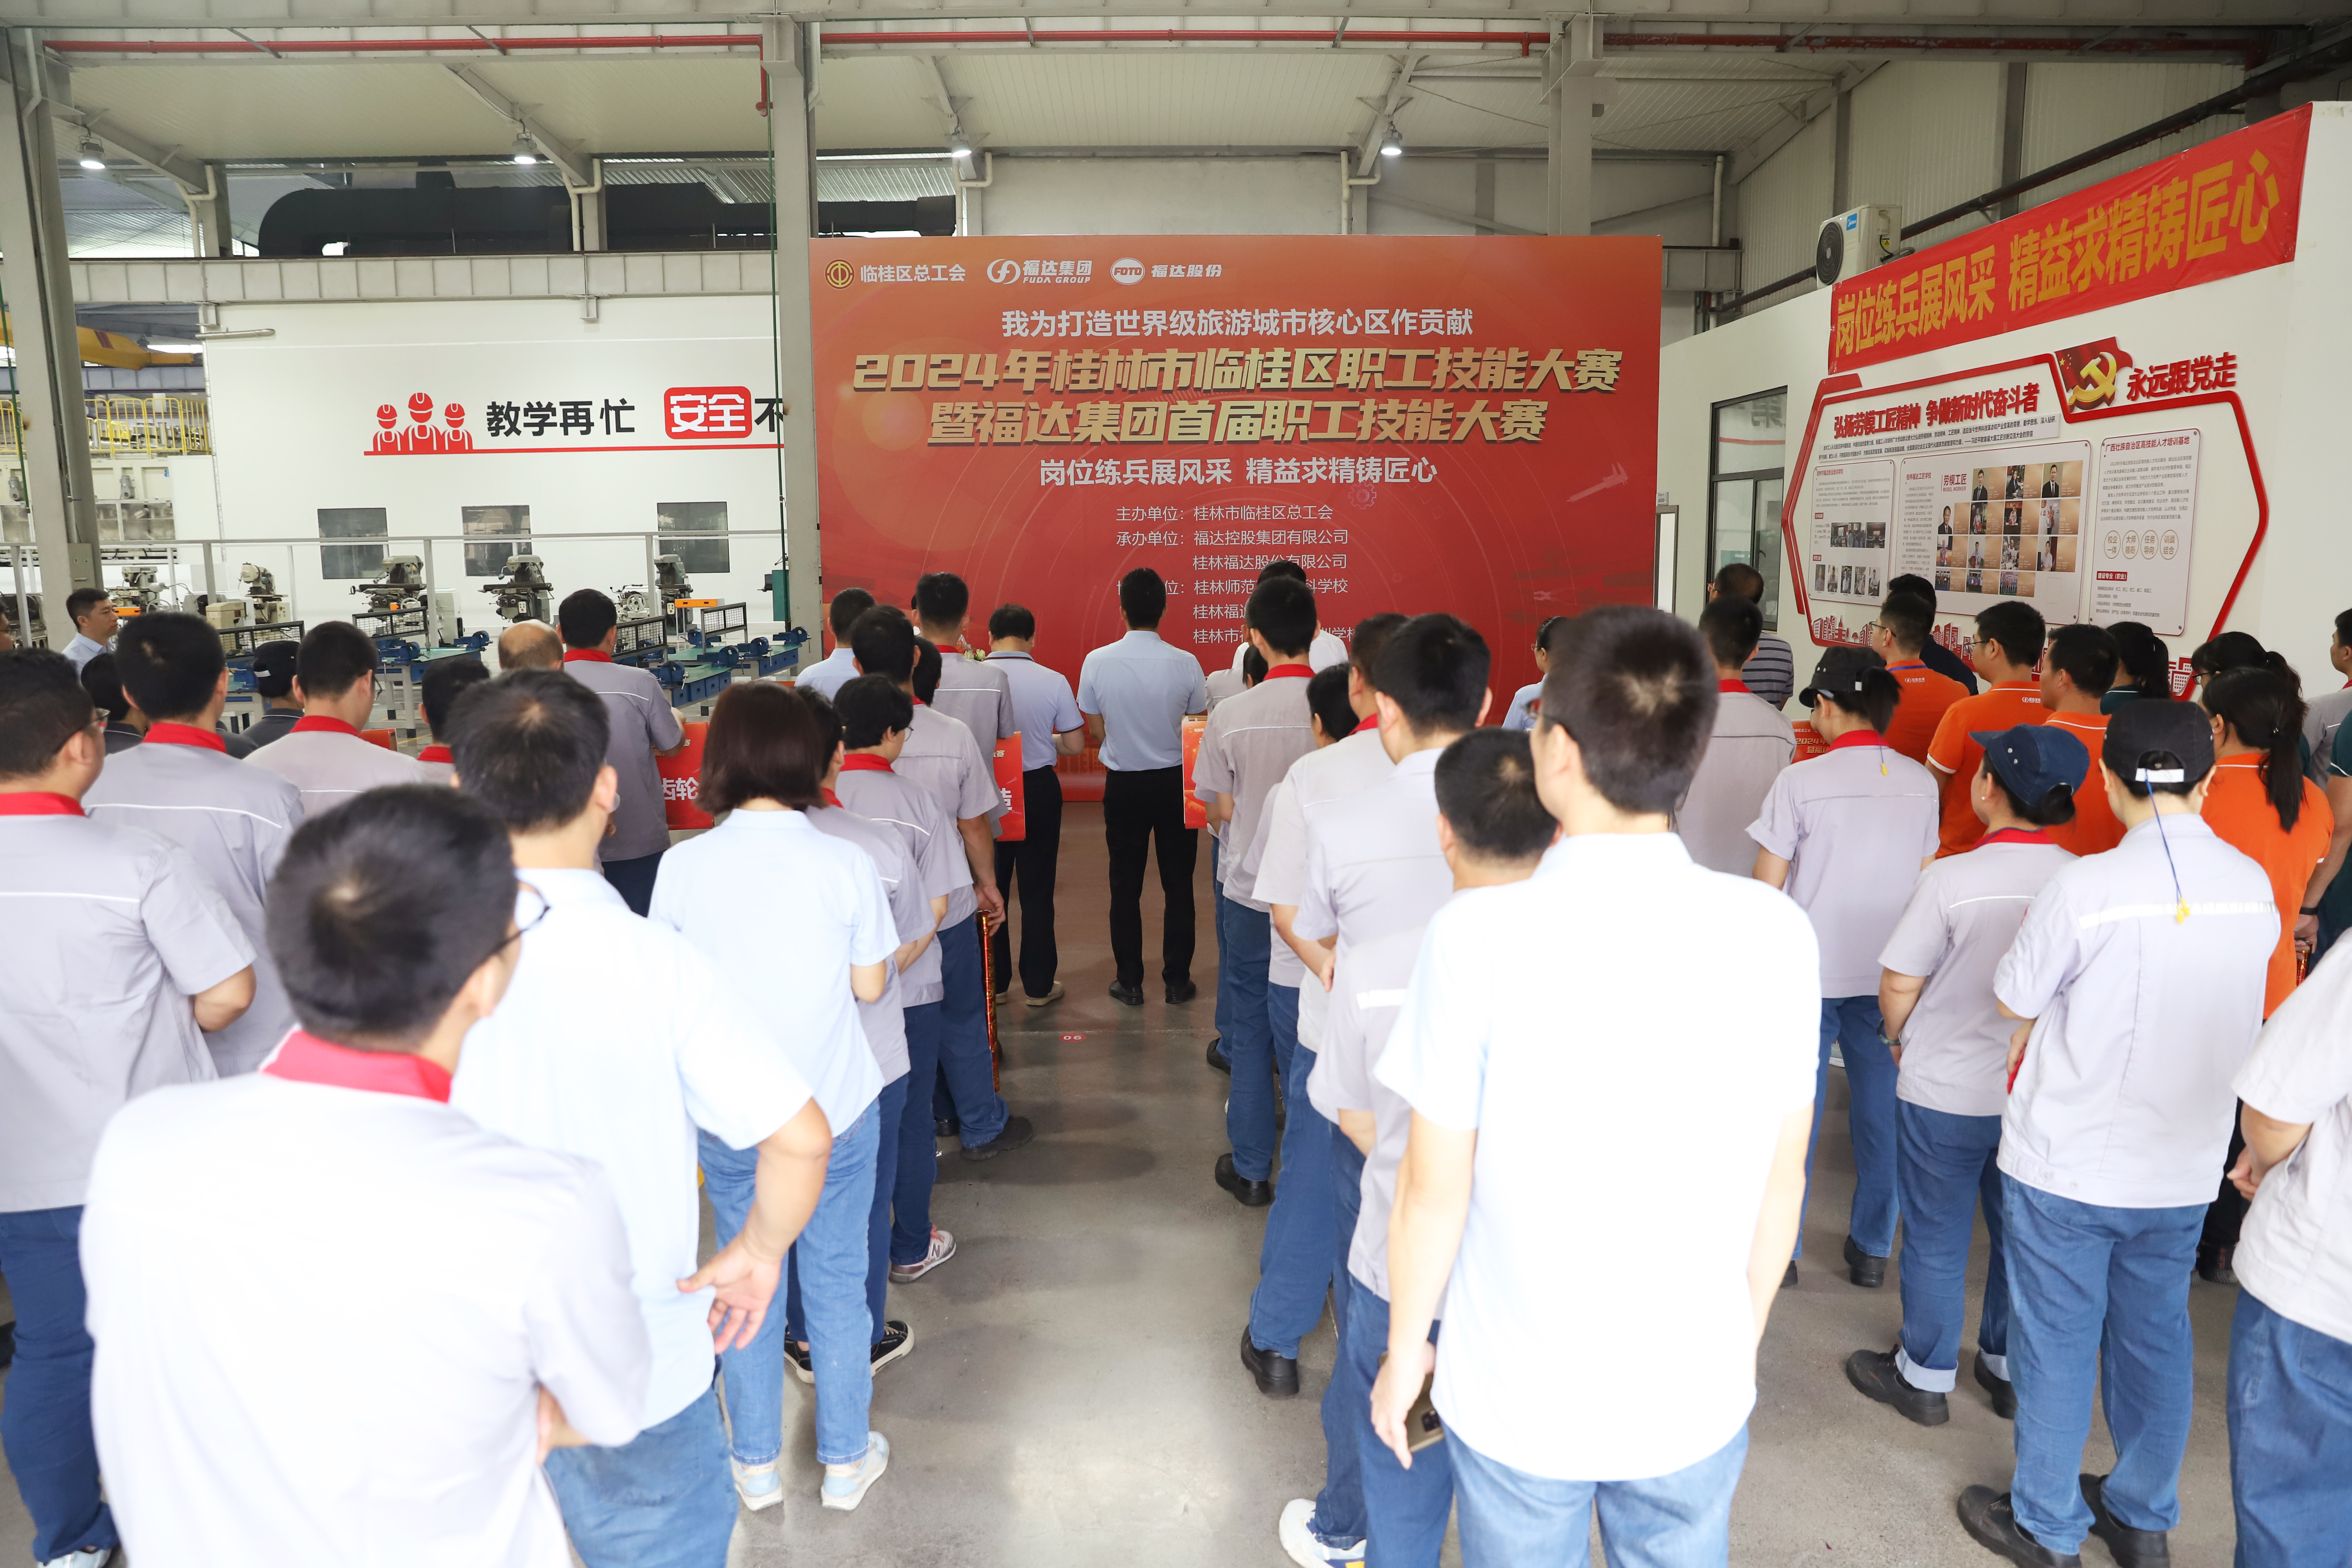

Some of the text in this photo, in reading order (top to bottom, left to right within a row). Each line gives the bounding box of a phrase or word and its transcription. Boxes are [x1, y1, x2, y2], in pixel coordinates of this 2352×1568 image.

[1836, 149, 2280, 357] 岗位练兵展风采 精益求精铸匠心
[861, 264, 966, 283] 临桂区总工会
[1023, 260, 1093, 276] 福达集团
[1114, 267, 1142, 276] FOTO
[1152, 265, 1222, 278] 福达股份
[1002, 308, 1473, 337] 我为打造世界级旅游城市核心区作贡献
[853, 347, 1623, 392] 2024年桂林市临桂区职工技能大赛
[2127, 352, 2237, 401] 永远跟党走
[487, 398, 635, 437] 教学再忙
[1834, 382, 2040, 439] 弘扬劳模工匠精神 争做新时代奋斗者
[928, 398, 1548, 443] 暨福达集团首届职工技能大赛
[2105, 436, 2190, 452] 广西壮族自治区高技能人才培训基地
[1041, 457, 1438, 486] 岗位练兵展风采 精益求精铸匠心
[1943, 473, 1967, 486] 劳模工匠
[2108, 535, 2118, 544] 校企
[2126, 535, 2136, 544] 大师
[2145, 535, 2155, 544] 任务
[2107, 546, 2117, 554] 一体
[2144, 546, 2154, 555] 导向
[2163, 546, 2174, 555] 结合
